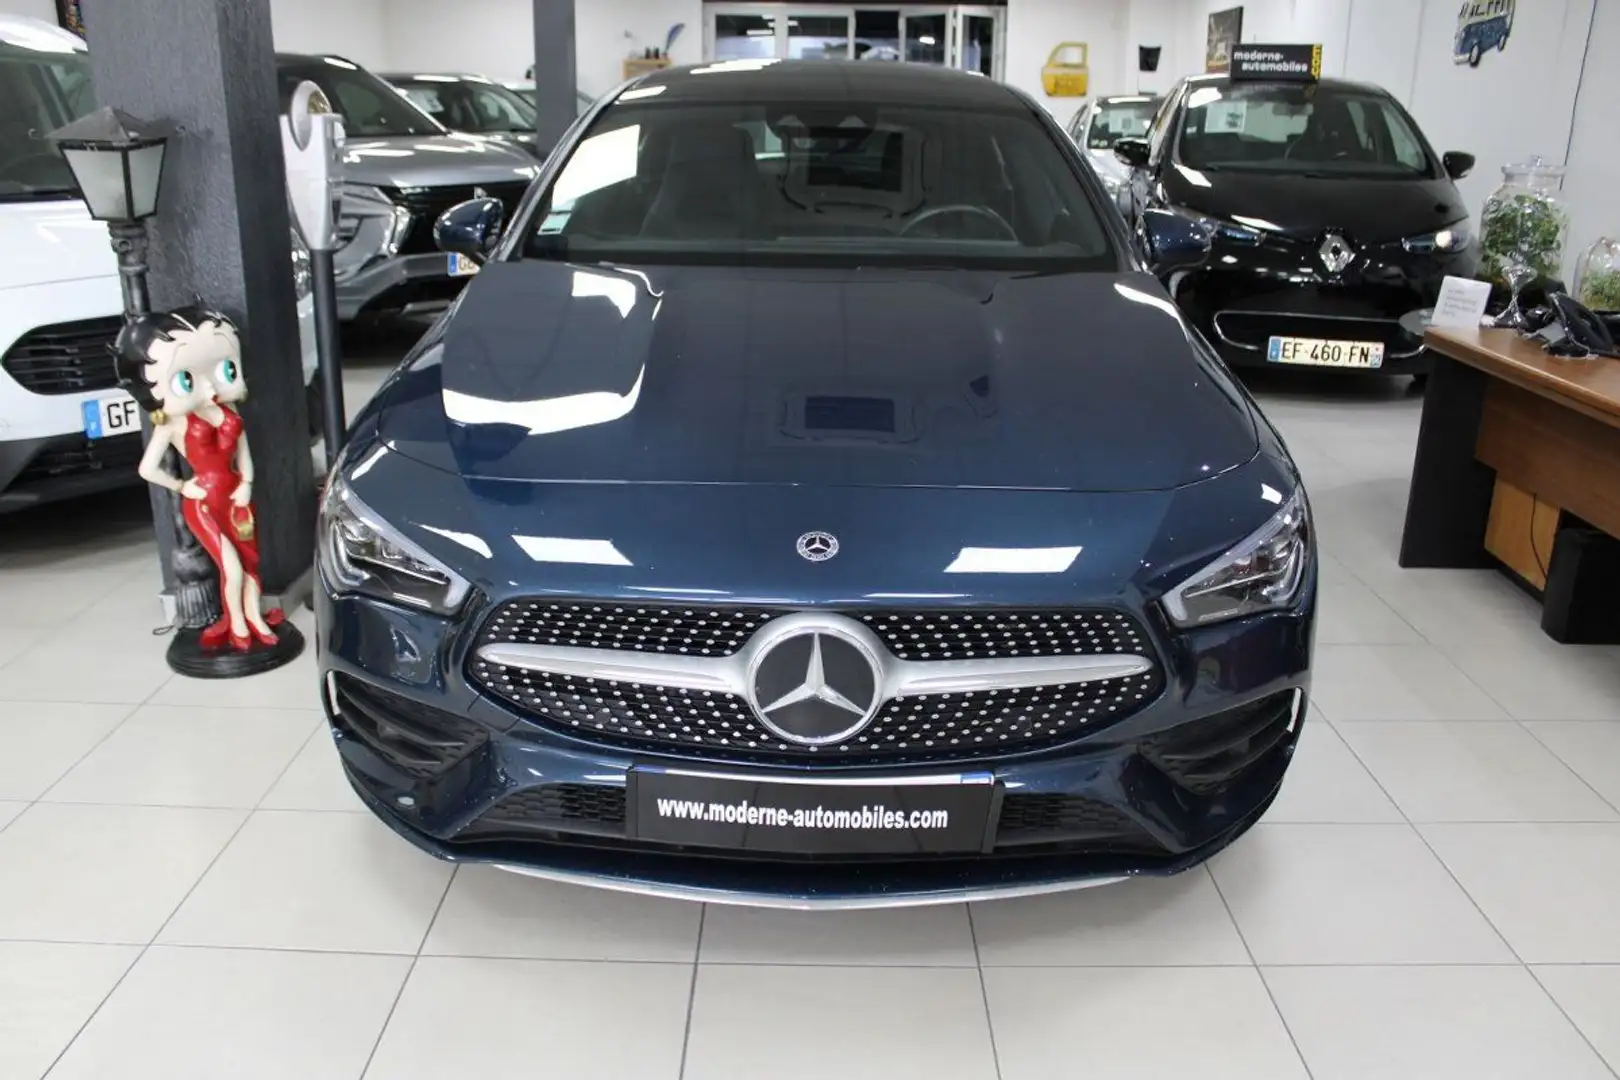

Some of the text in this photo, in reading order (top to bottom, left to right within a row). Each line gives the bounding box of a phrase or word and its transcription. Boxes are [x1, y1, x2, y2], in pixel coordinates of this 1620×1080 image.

[1234, 50, 1284, 61] moderne-
[1242, 61, 1308, 72] automobiles
[107, 400, 136, 428] GF
[657, 798, 948, 829] www.moderne-automobiles.com
